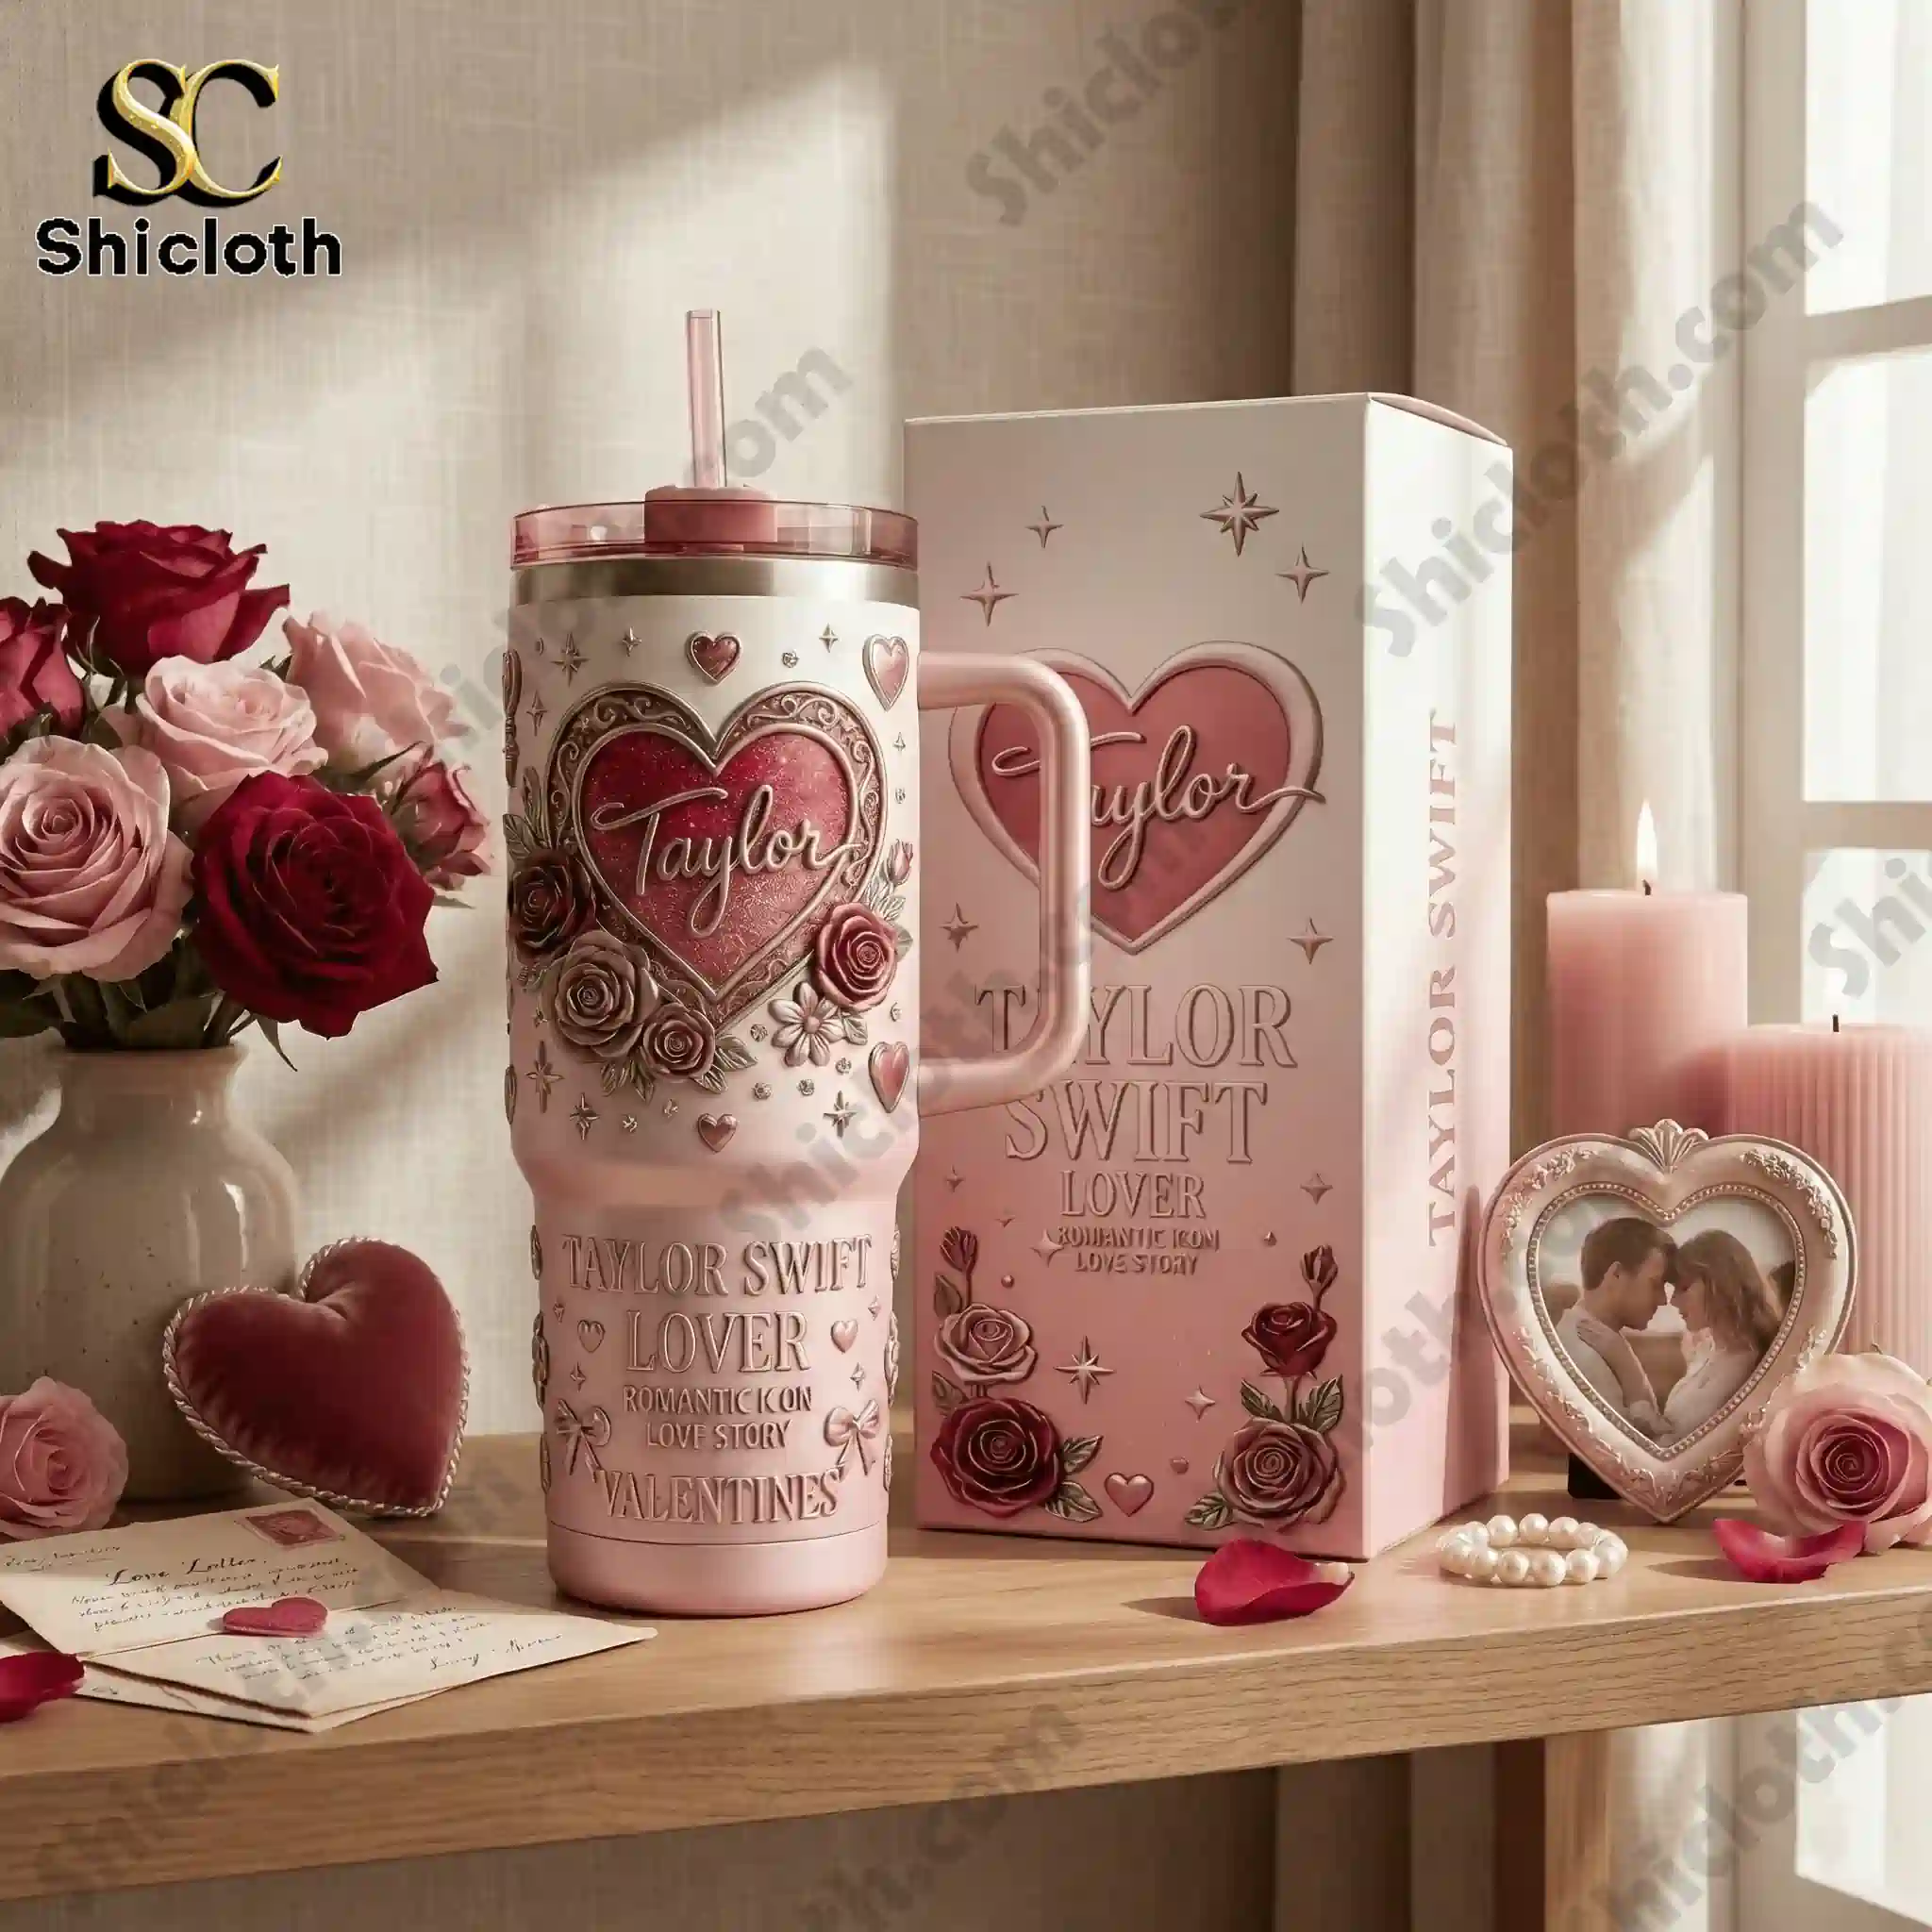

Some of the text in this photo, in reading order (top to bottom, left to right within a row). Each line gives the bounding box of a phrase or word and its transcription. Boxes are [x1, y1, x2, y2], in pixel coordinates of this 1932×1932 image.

[991, 724, 1326, 891] Tylor
[590, 784, 870, 939] Taylor
[1427, 707, 1457, 1248] TAYLOR SWIFT
[974, 984, 1298, 1068] TYLOR
[1005, 1078, 1268, 1164] SWIFT
[1059, 1169, 1207, 1219] LOVER
[562, 1235, 873, 1296] TAYLOR SWIFT
[1074, 1252, 1199, 1275] LOVE STORY
[625, 1309, 811, 1374] LOVER
[623, 1385, 812, 1415] ROMANTIC ICON
[645, 1418, 793, 1450] LOVE STORY
[595, 1465, 846, 1525] VALENTINES
